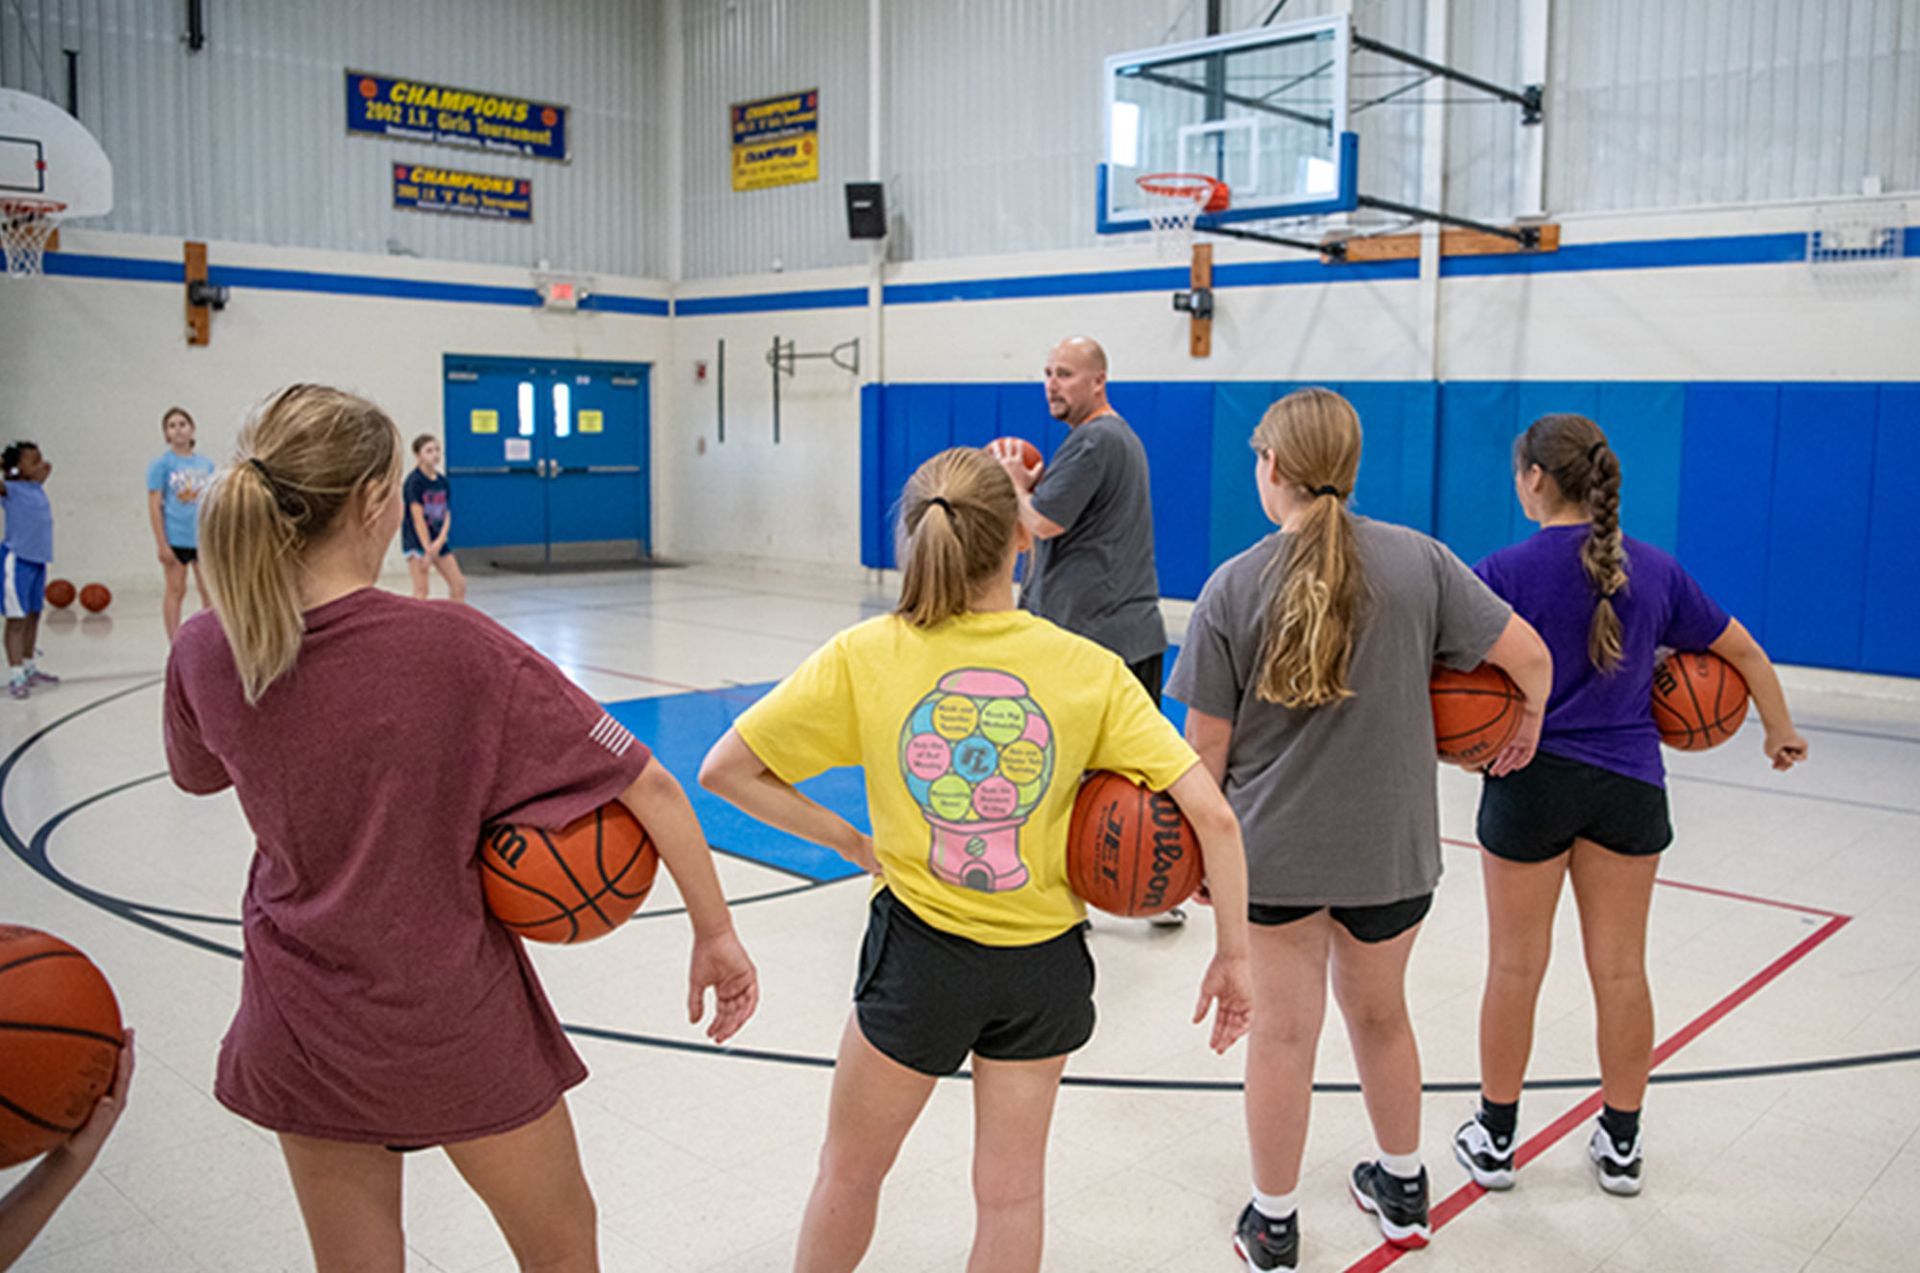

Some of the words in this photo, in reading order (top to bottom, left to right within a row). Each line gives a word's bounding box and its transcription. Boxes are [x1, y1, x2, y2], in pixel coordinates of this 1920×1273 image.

[390, 82, 528, 122] CHAMPIONS
[477, 117, 552, 146] Tournament
[410, 166, 515, 195] CHAMPIONS
[1102, 801, 1124, 892] JET
[1141, 793, 1184, 909] Wilson
